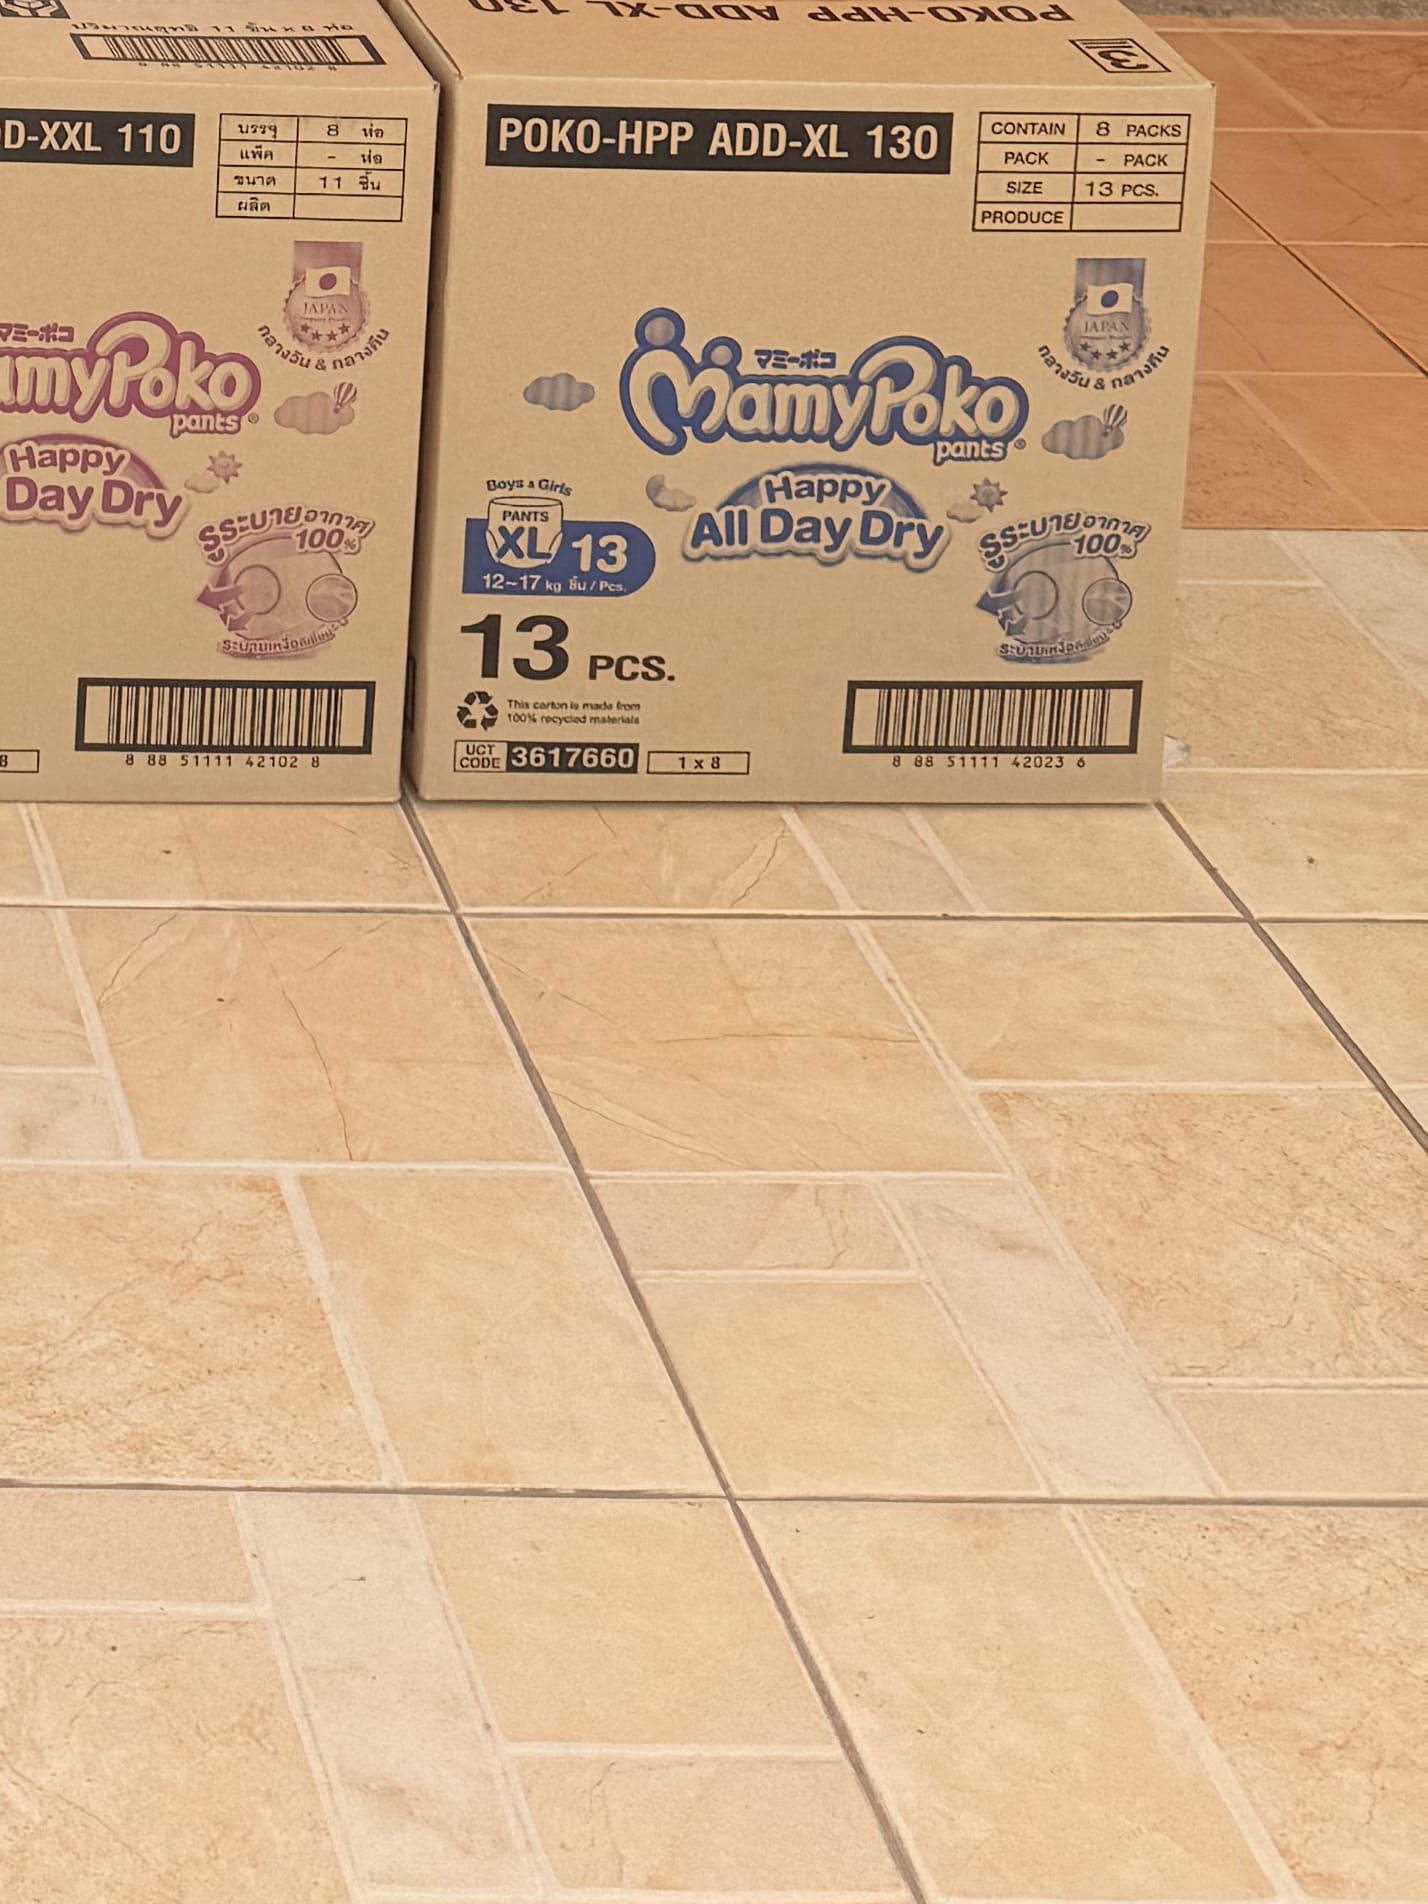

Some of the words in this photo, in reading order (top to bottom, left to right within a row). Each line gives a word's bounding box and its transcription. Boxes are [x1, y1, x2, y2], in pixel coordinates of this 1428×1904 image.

[116, 123, 183, 154] 110
[497, 116, 696, 156] POKO-HPP
[709, 121, 850, 160] ADD-XL
[866, 124, 940, 161] 130
[459, 613, 570, 681] 13
[588, 654, 676, 682] PCS.
[245, 755, 298, 769] 42102
[511, 745, 635, 769] 3617660
